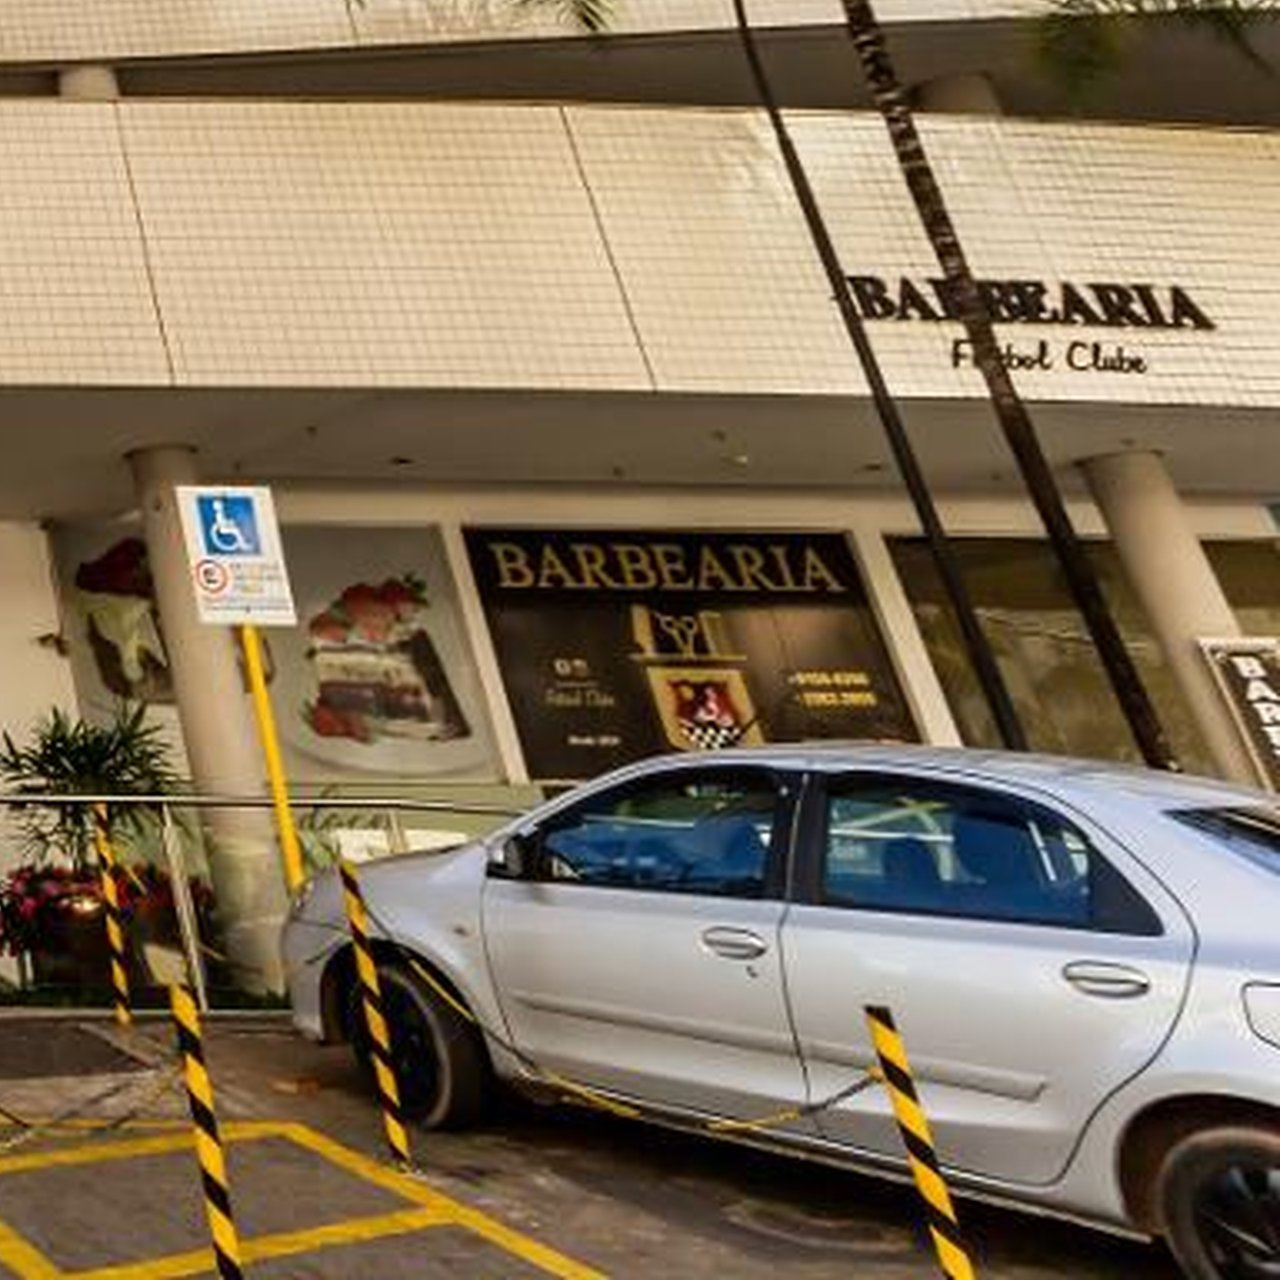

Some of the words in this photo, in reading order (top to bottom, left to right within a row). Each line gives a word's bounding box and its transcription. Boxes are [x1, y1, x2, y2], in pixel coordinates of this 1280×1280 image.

[844, 275, 1218, 330] BABEARIA
[951, 338, 1053, 373] Fbol
[1065, 342, 1148, 375] Clube
[490, 542, 844, 592] BARBEARIA
